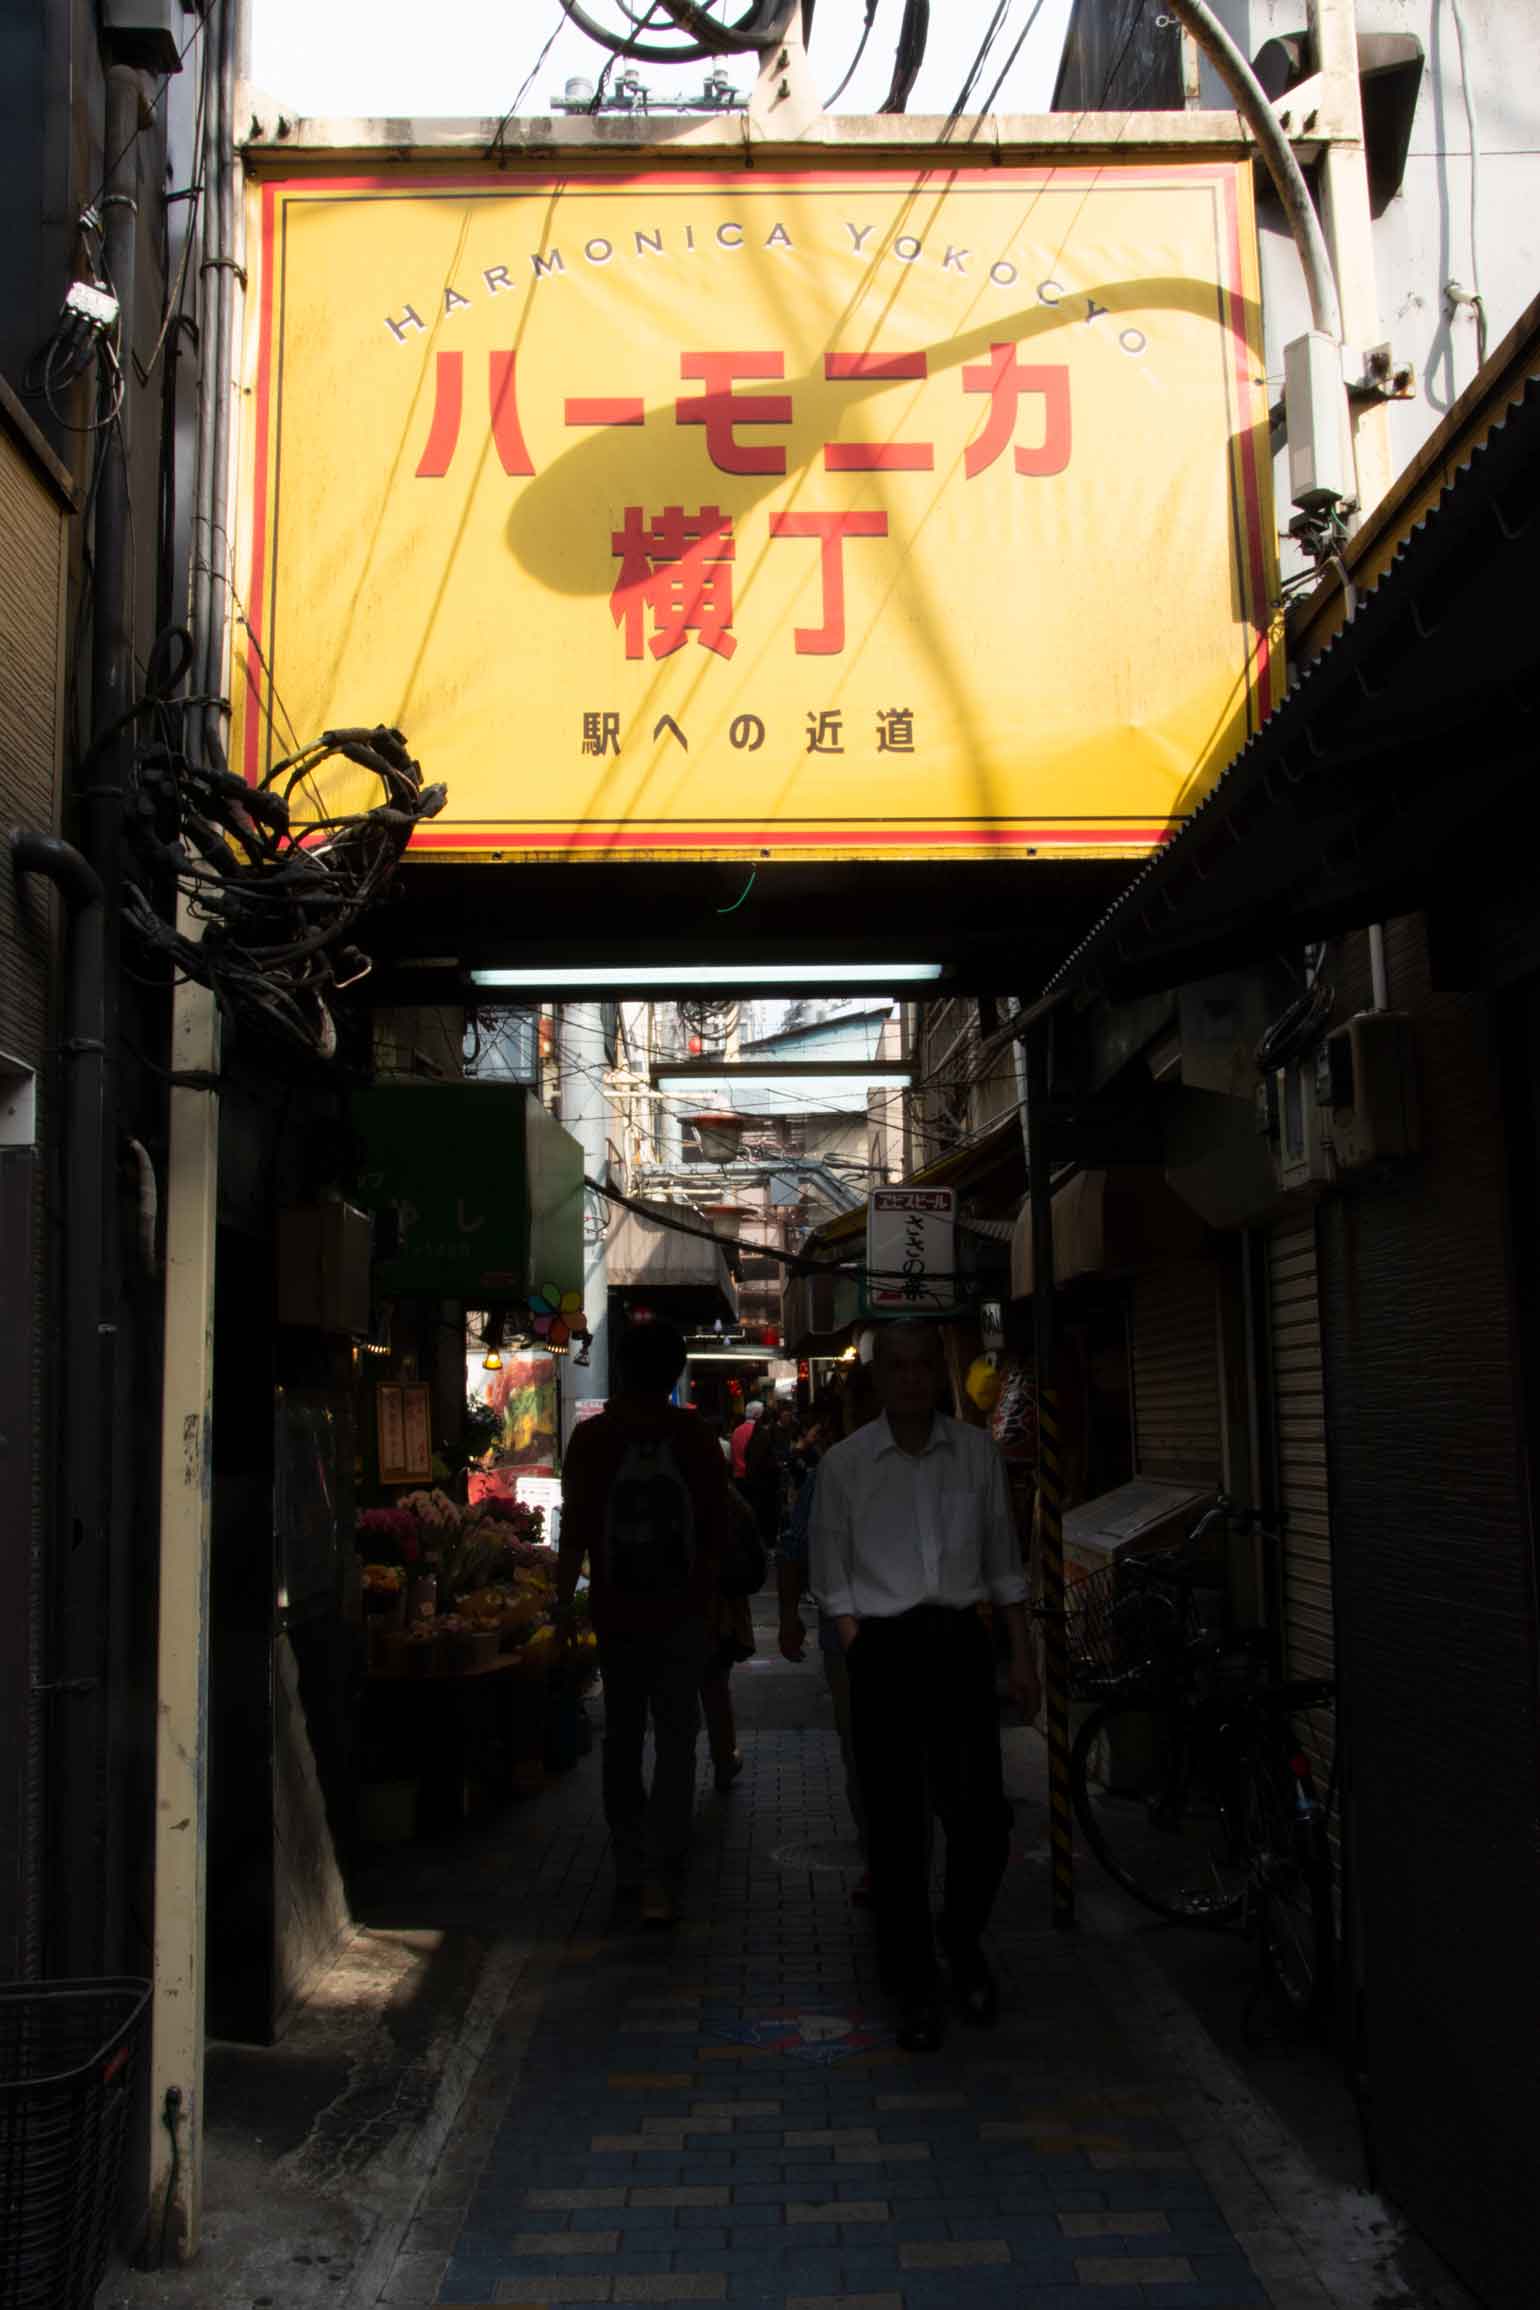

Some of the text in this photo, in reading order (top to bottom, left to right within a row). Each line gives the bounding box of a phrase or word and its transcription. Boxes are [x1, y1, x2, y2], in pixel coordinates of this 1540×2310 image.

[383, 221, 1147, 354] HARMONICA YOKOCYO
[414, 341, 1073, 480] ハーモニカ
[609, 505, 890, 661] 横丁
[580, 706, 916, 756] 駅への近道
